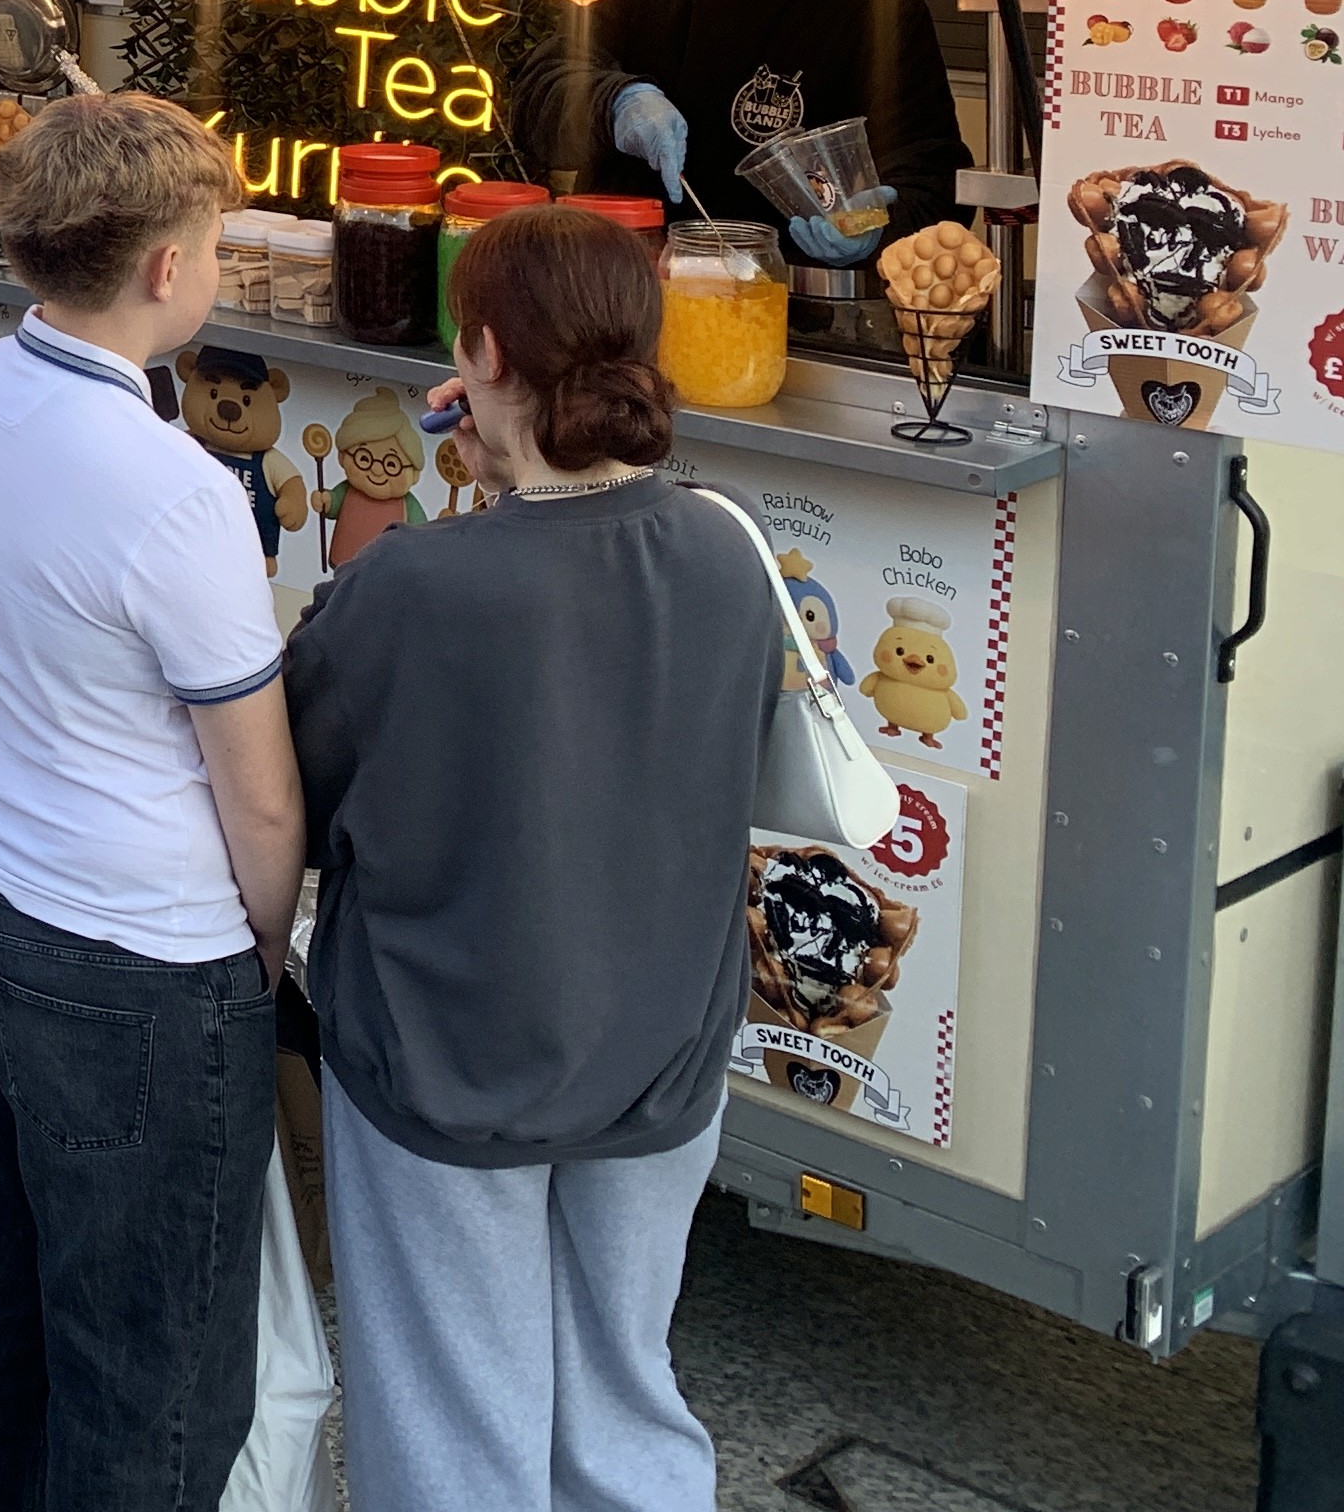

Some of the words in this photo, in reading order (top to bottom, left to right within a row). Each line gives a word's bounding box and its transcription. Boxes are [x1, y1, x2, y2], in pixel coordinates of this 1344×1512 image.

[335, 27, 495, 133] Tea
[1070, 70, 1203, 106] BUBBLE
[744, 100, 791, 119] BUBBLE
[1223, 88, 1243, 102] T1
[1254, 91, 1305, 108] Mango
[746, 113, 783, 129] LAND
[1100, 111, 1167, 142] TEA
[1221, 123, 1242, 137] T3
[1253, 126, 1302, 142] Lychee
[1099, 335, 1166, 352] SWEET
[1175, 339, 1239, 370] TOOTH
[763, 492, 835, 524] Rainbow
[899, 544, 943, 570] Bobo
[882, 567, 957, 601] Chicken
[873, 869, 930, 893] ice-cream
[755, 1028, 814, 1053] SWEET
[820, 1043, 875, 1083] TOOTH
